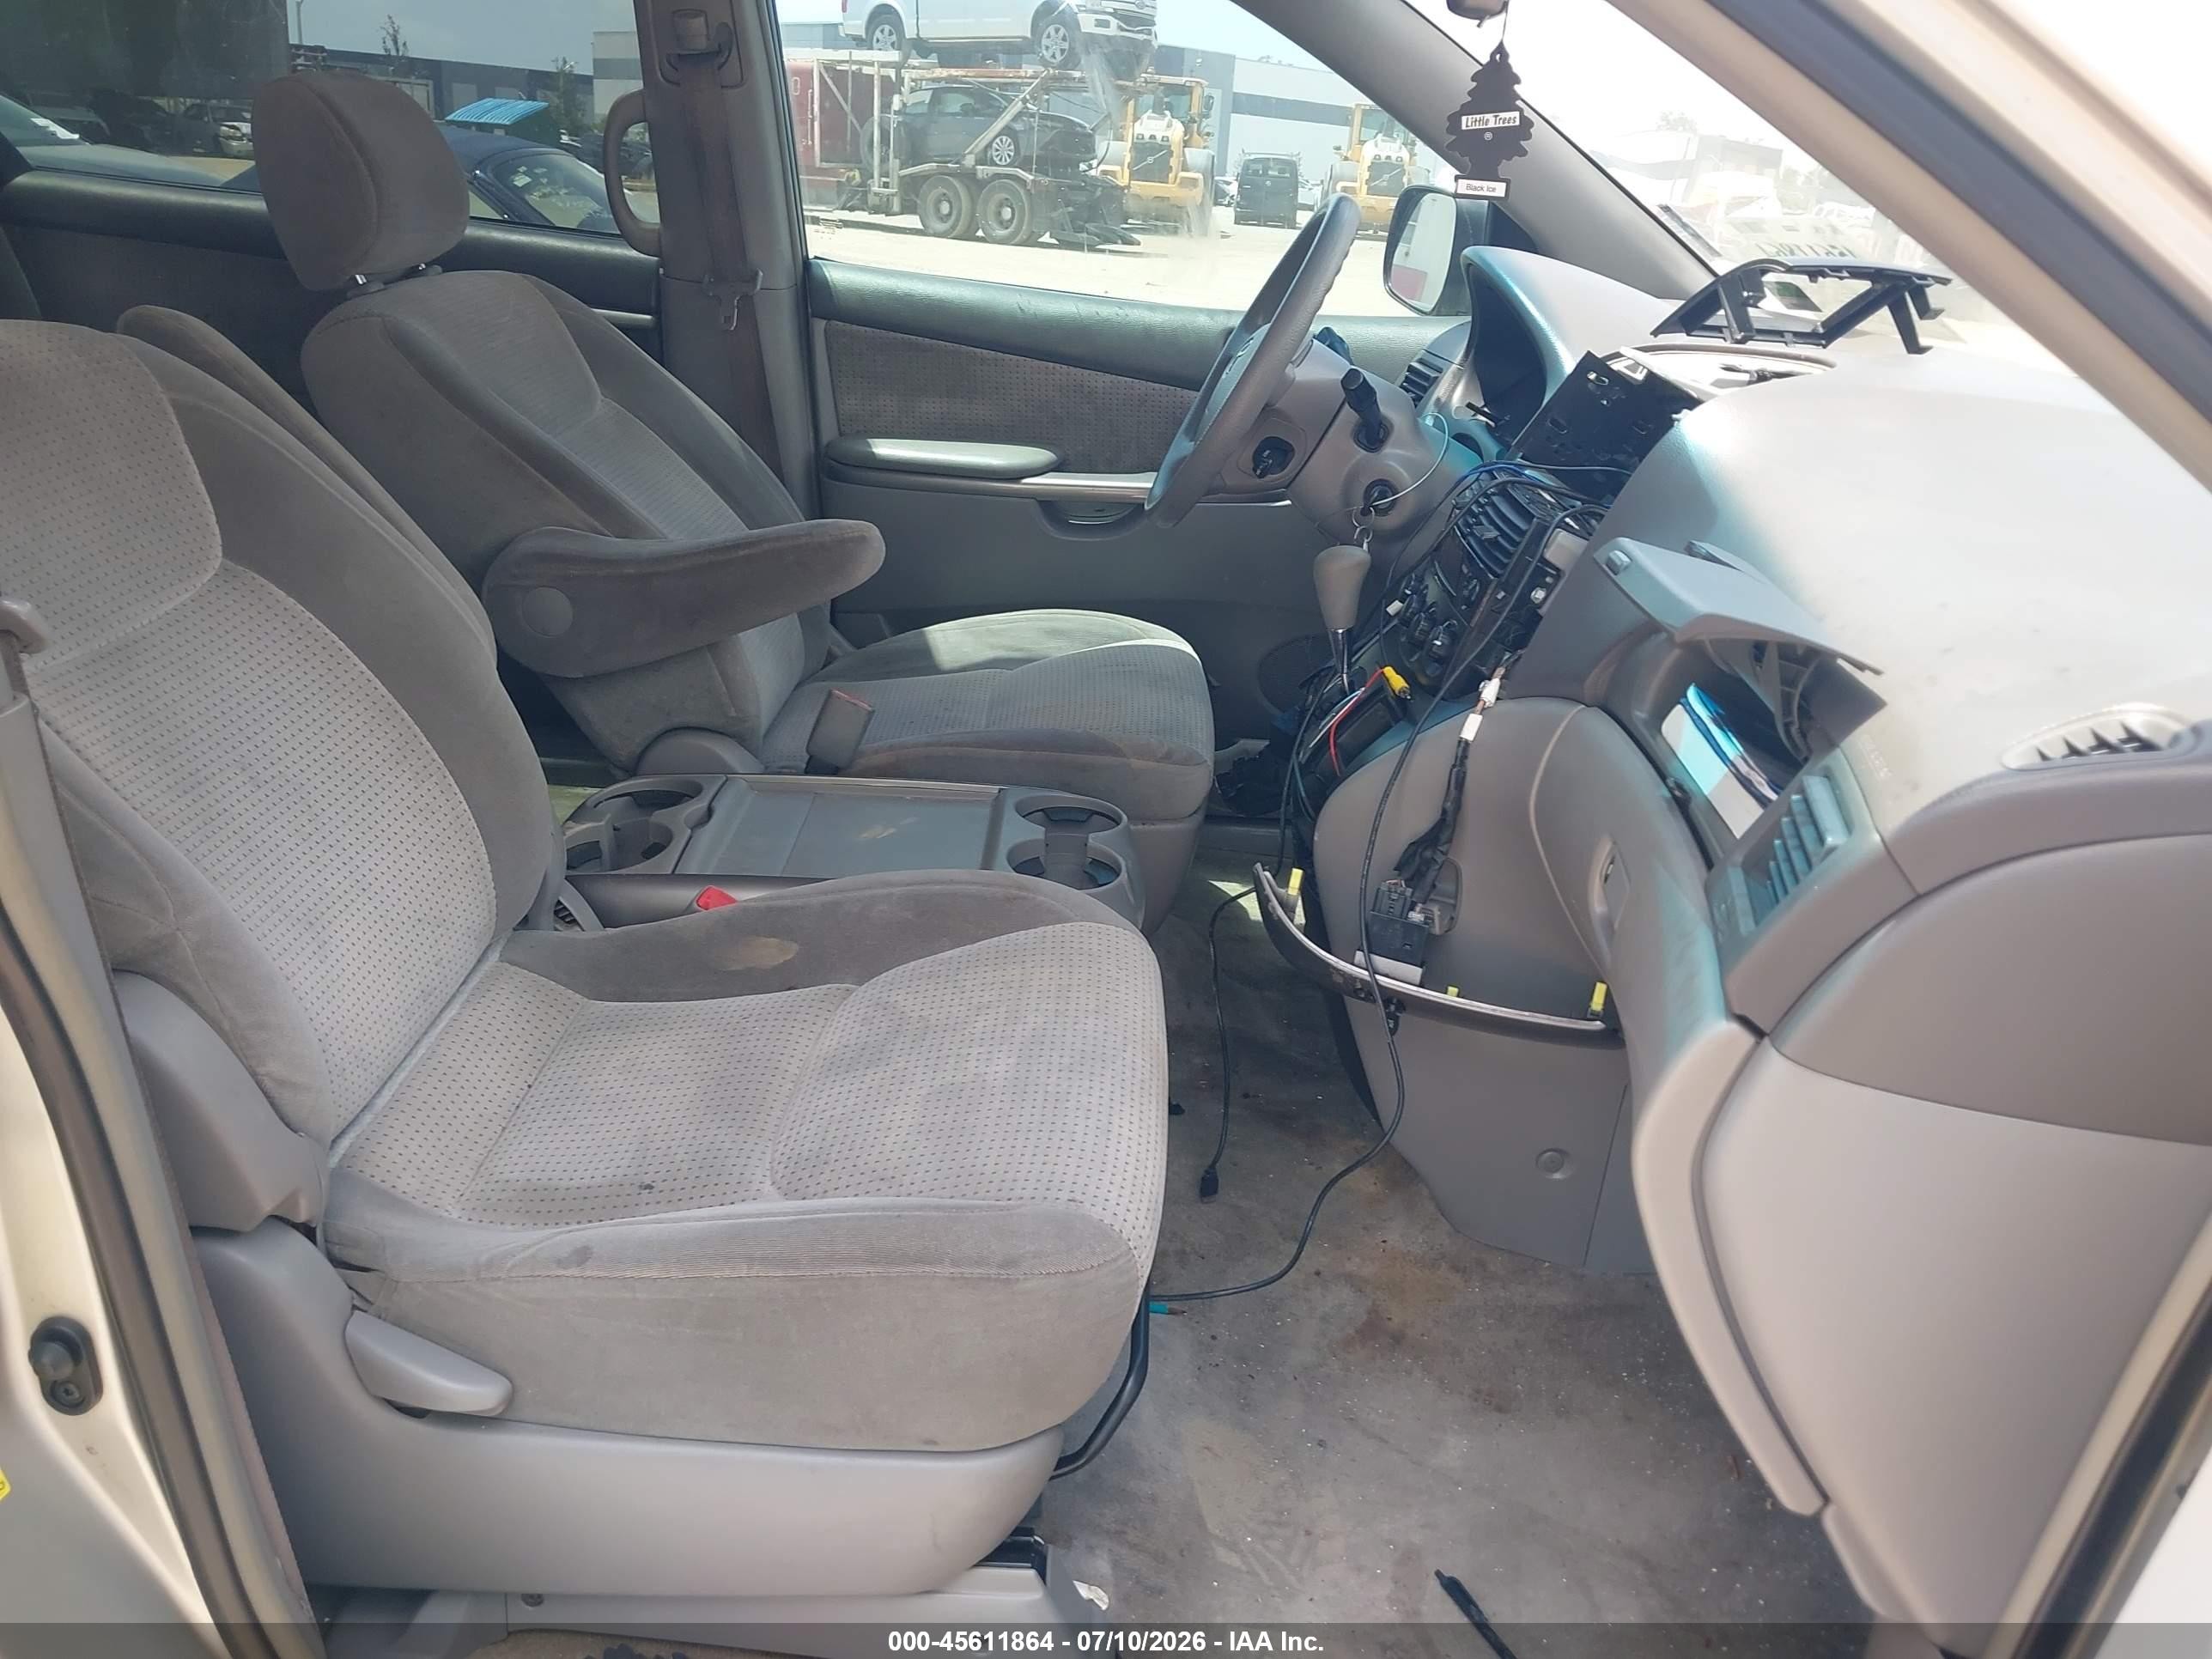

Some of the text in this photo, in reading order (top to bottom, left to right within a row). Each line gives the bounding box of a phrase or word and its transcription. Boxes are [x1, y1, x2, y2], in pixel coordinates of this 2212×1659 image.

[1465, 114, 1517, 128] Little Trees
[1466, 183, 1486, 191] Black
